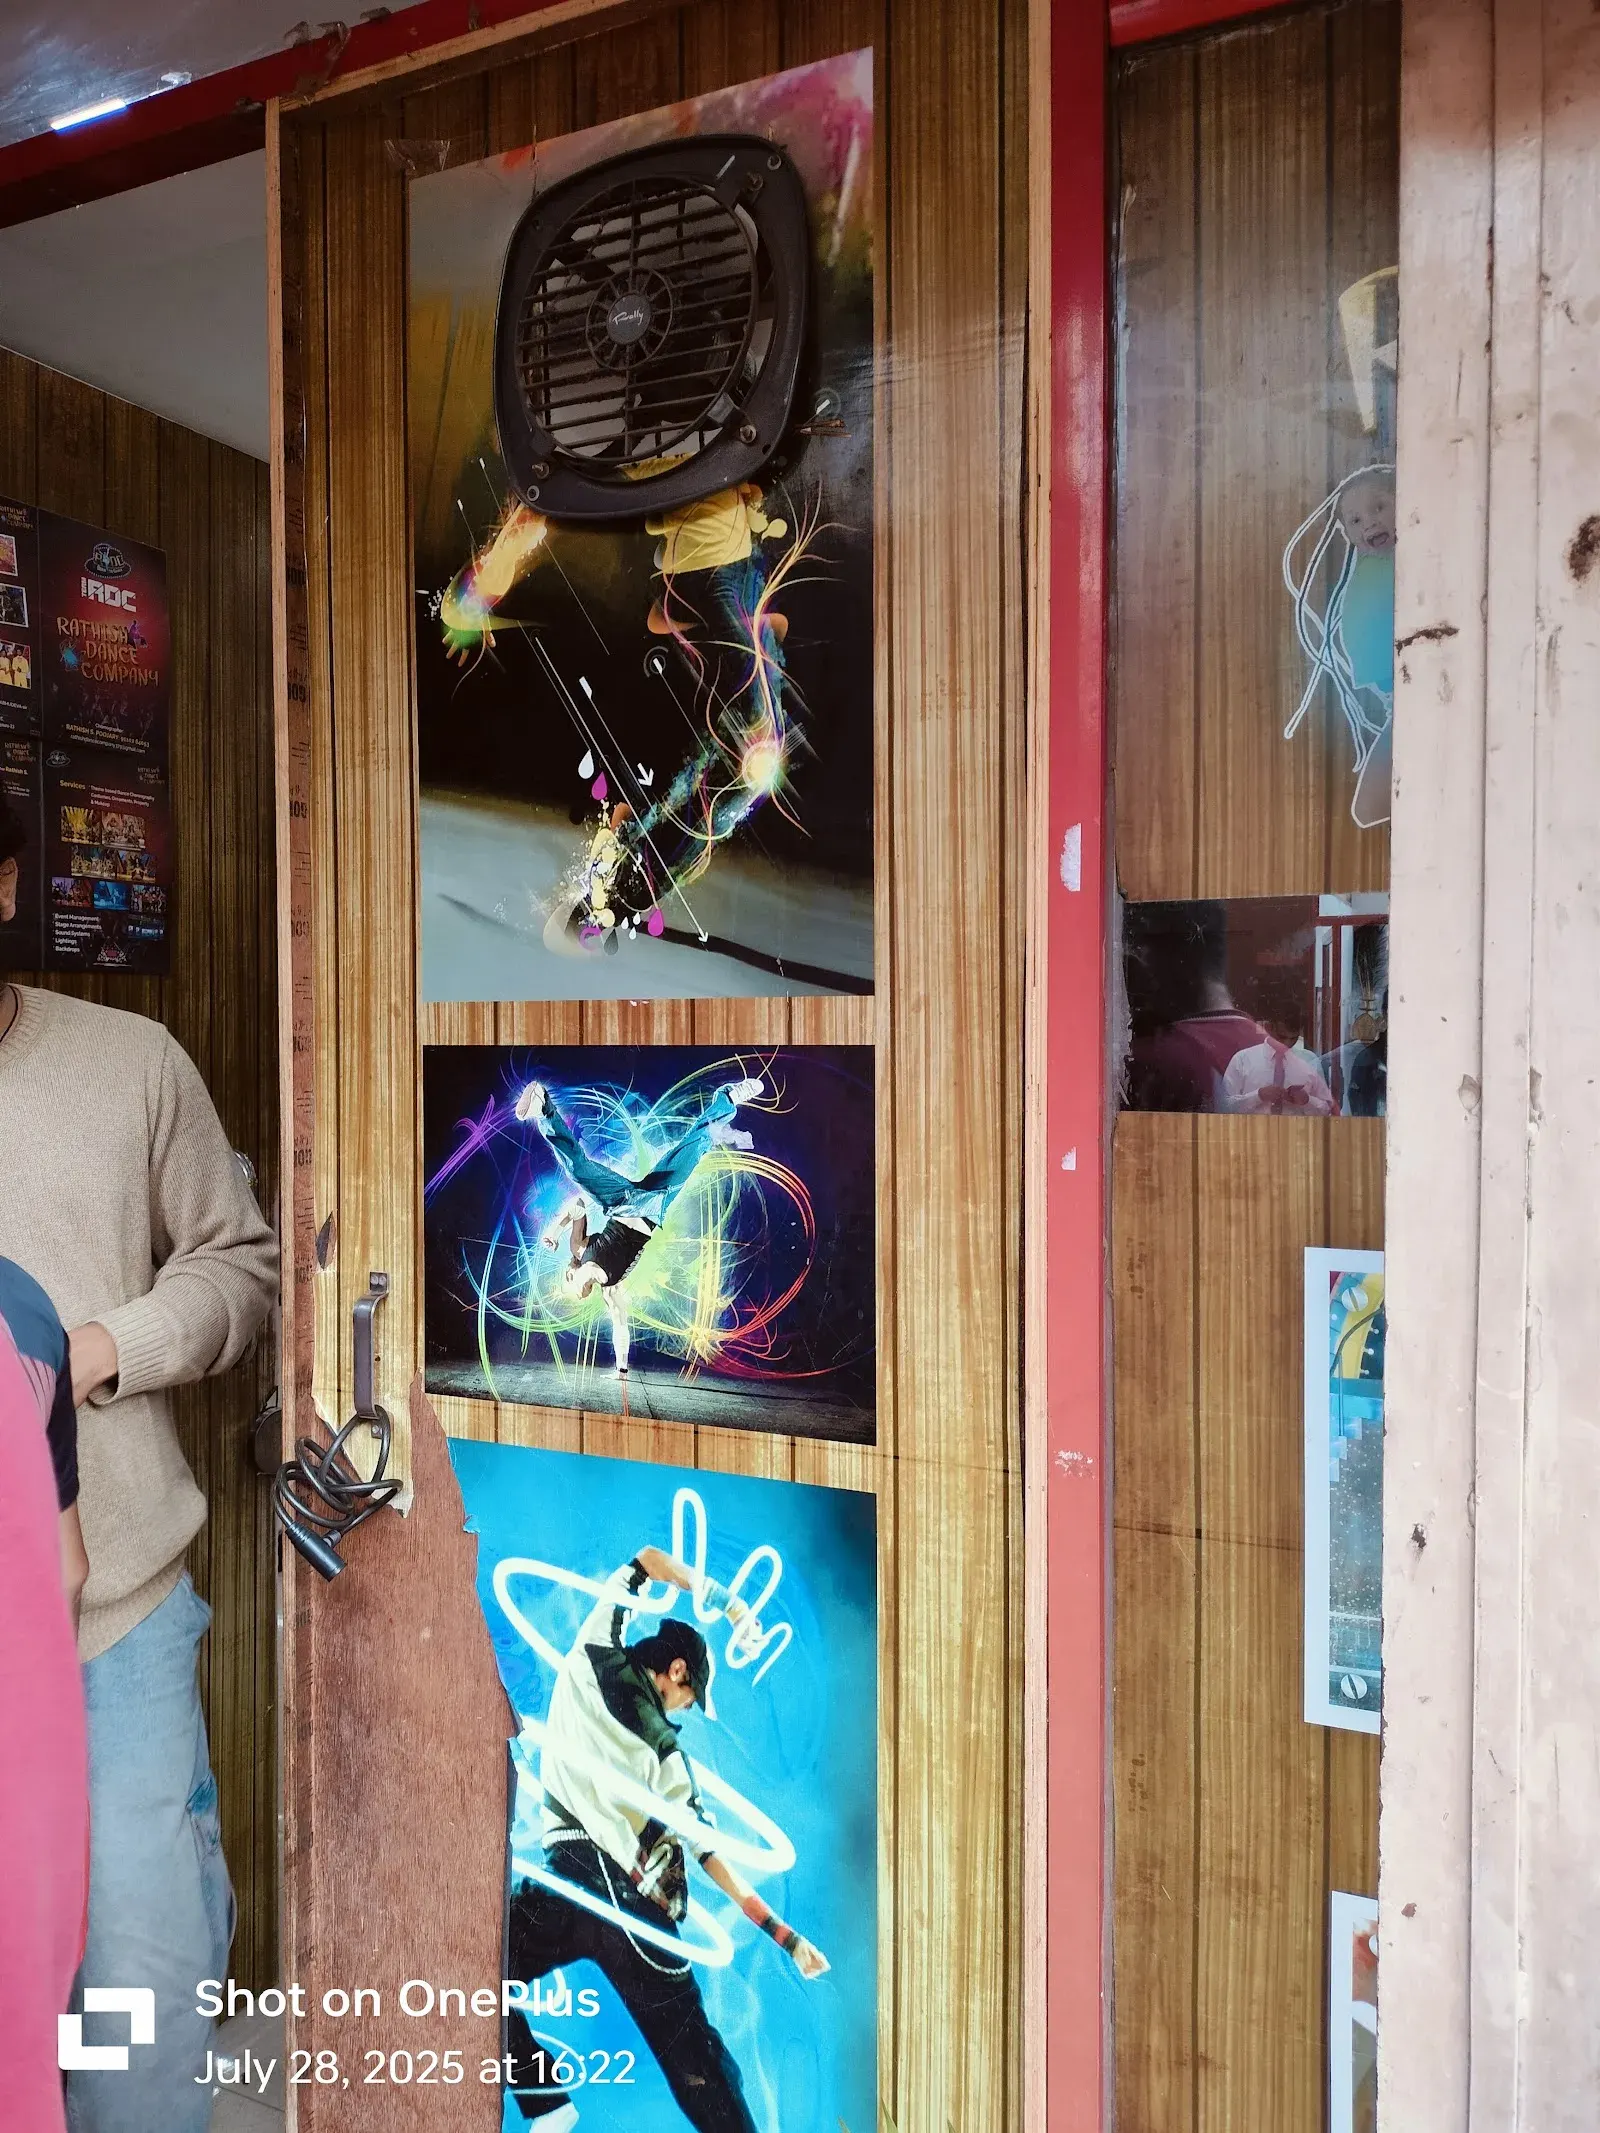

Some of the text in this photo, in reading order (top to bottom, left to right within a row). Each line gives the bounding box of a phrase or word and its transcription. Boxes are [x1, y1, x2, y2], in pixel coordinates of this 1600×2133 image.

[87, 578, 137, 613] RDC
[86, 640, 139, 665] DANCE
[81, 662, 159, 687] COMPANY
[60, 780, 86, 790] Services
[55, 912, 100, 922] Event Management
[55, 921, 102, 931] Stage Arrangements
[71, 930, 91, 938] Systems
